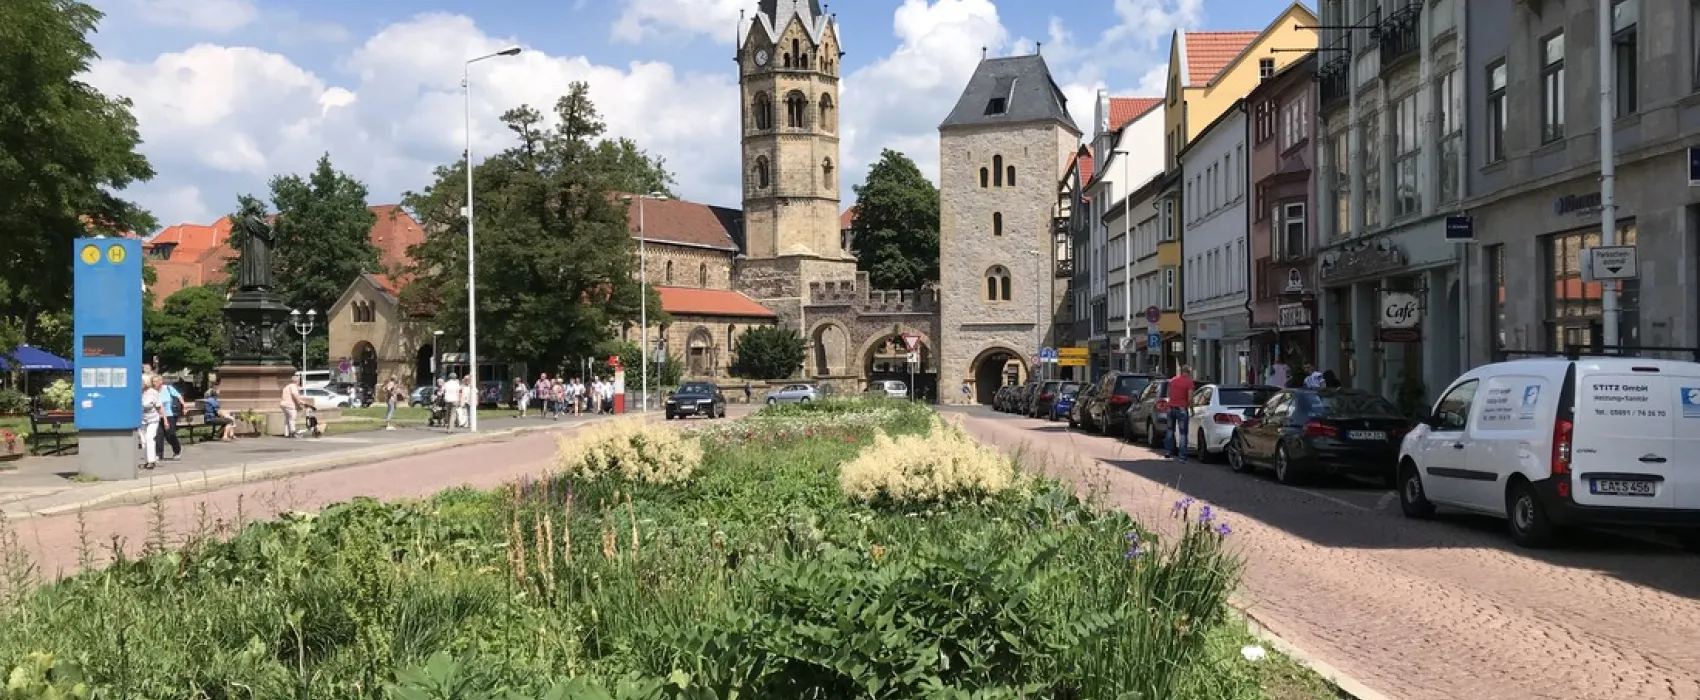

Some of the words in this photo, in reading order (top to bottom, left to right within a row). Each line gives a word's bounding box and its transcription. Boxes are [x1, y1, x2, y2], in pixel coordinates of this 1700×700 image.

[112, 248, 122, 260] H
[1386, 301, 1416, 324] Café
[1601, 481, 1616, 491] EA
[1631, 481, 1650, 492] 456
